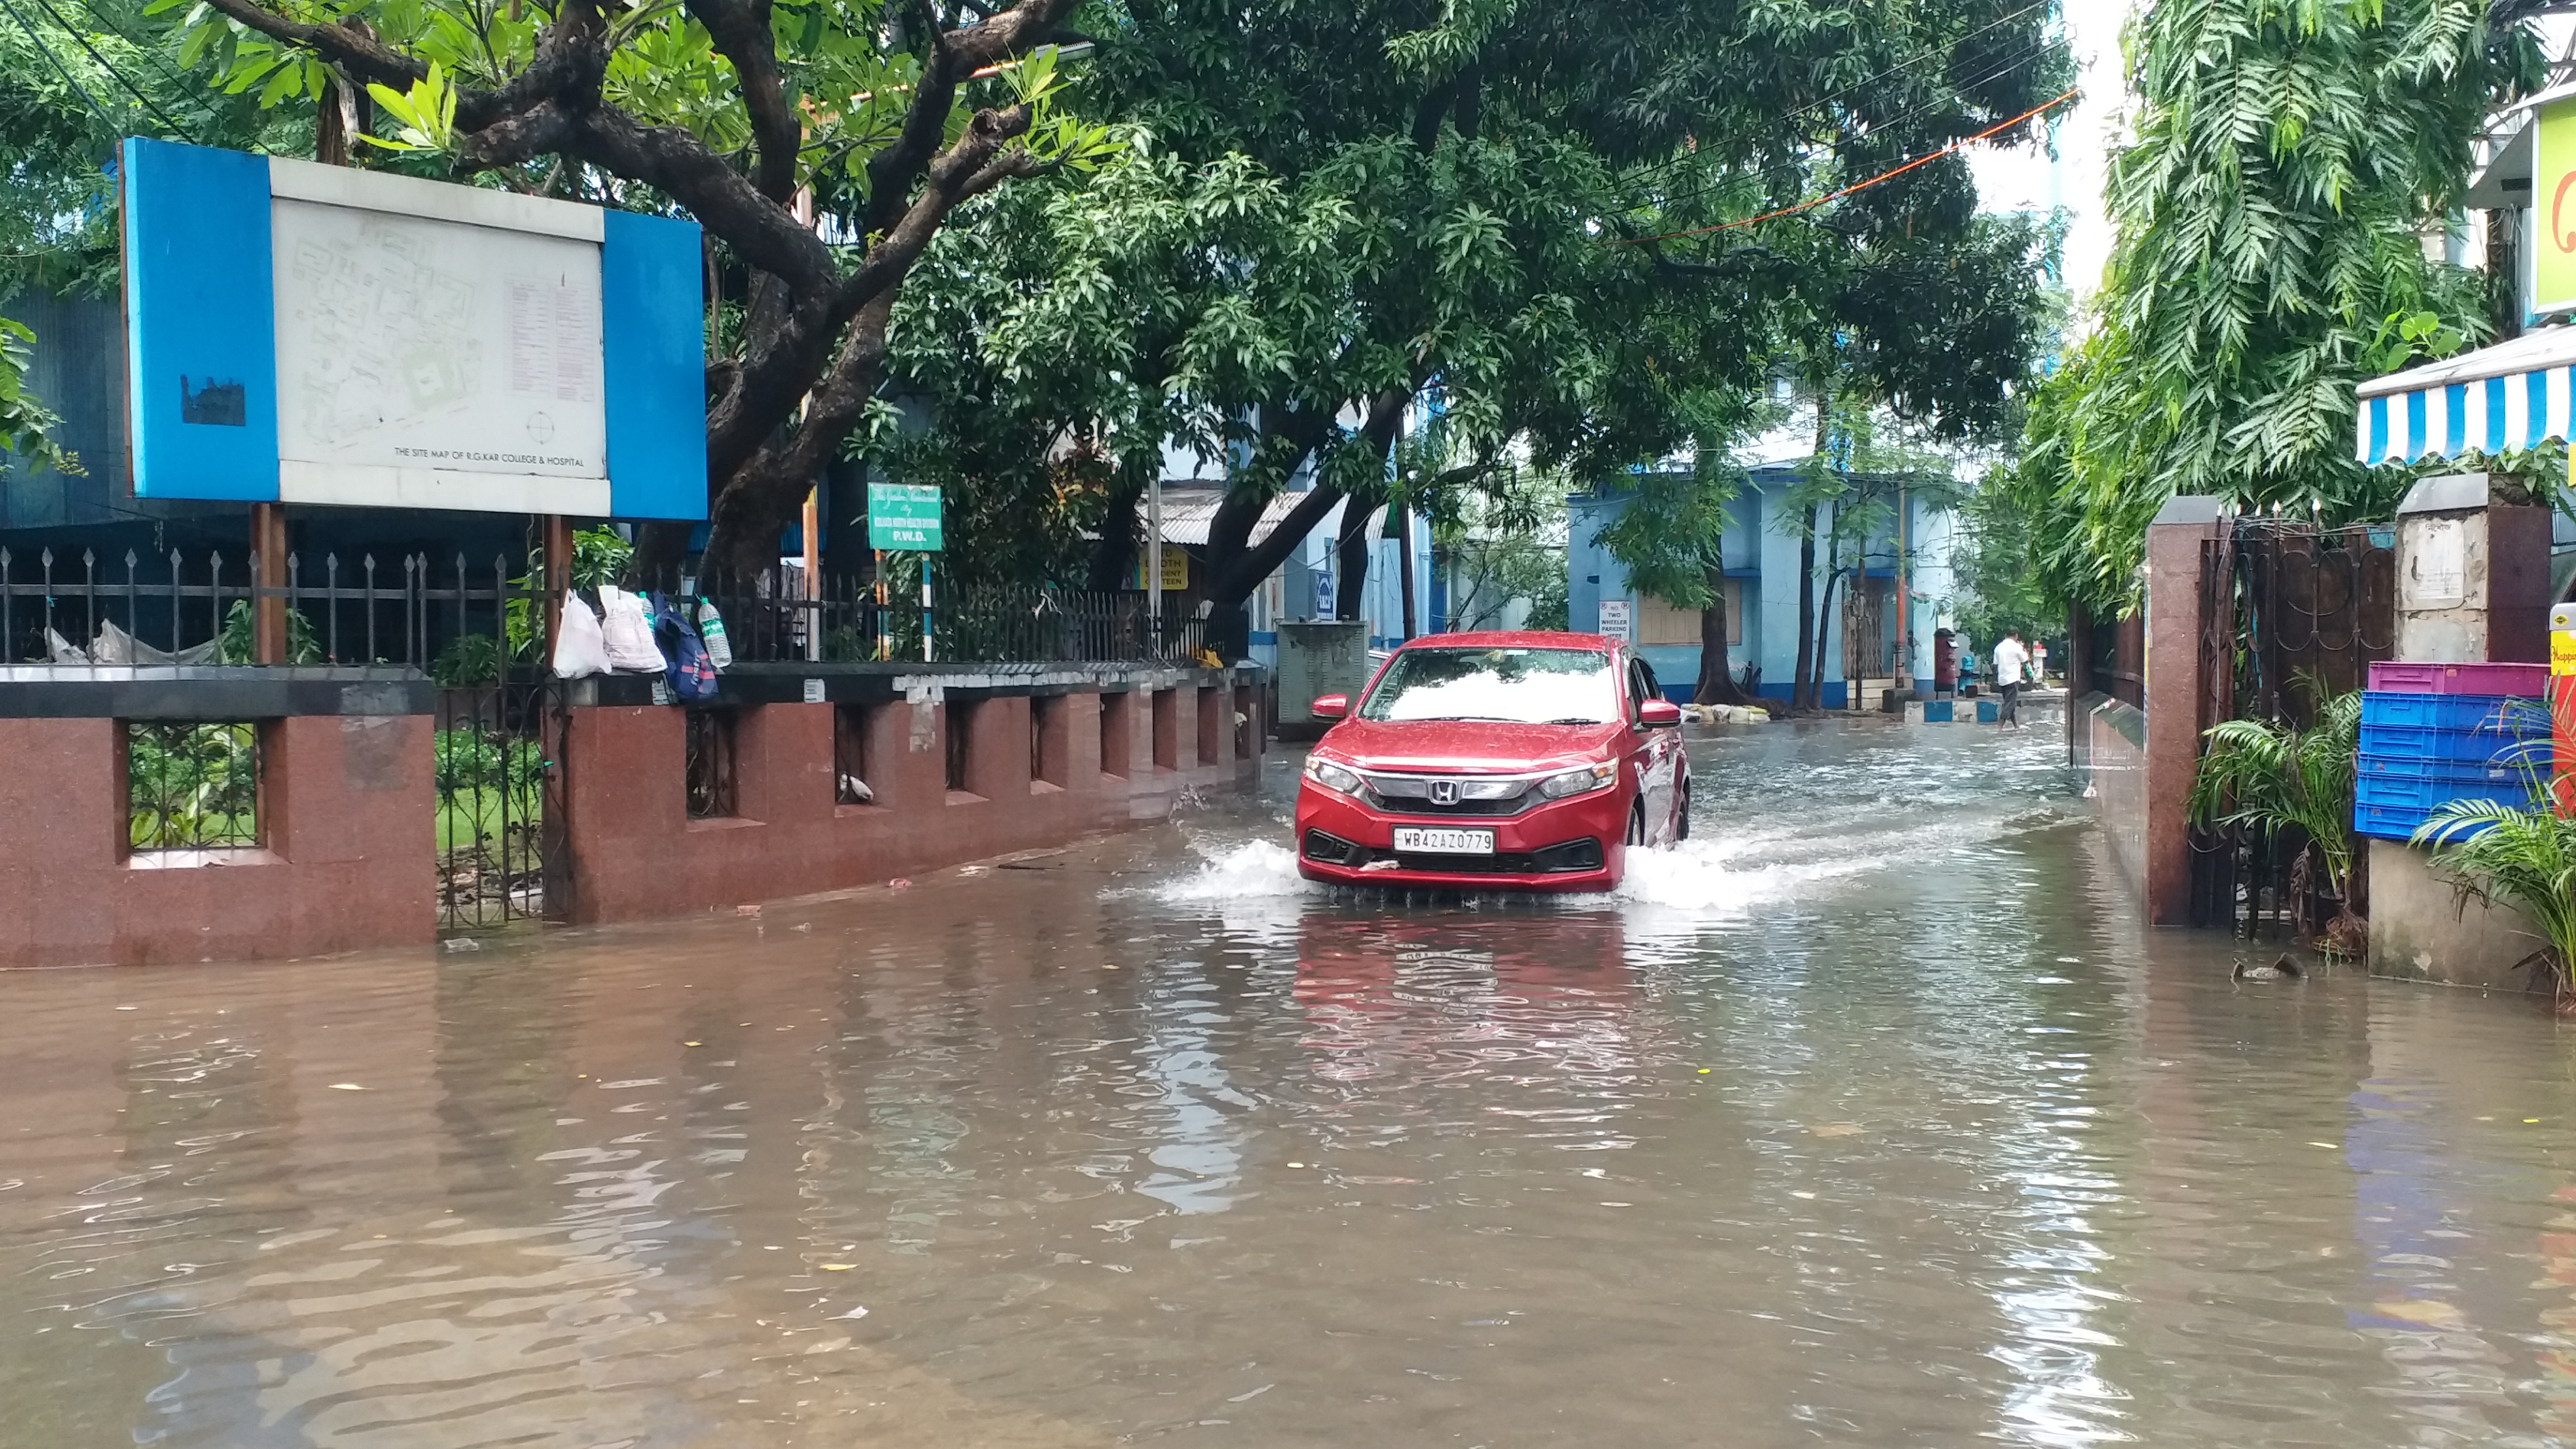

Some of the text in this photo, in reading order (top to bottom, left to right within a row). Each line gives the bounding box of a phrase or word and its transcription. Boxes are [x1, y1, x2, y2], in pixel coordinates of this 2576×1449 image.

[395, 447, 409, 456] THE
[412, 449, 428, 458] SITE
[432, 451, 449, 459] MAP
[452, 451, 464, 460] OF
[502, 453, 537, 464] COLLEGE
[539, 456, 545, 465] &
[547, 457, 585, 467] HOSPITAL
[893, 530, 927, 542] P.W.D.
[1404, 831, 1492, 850] WB42AZ0779
